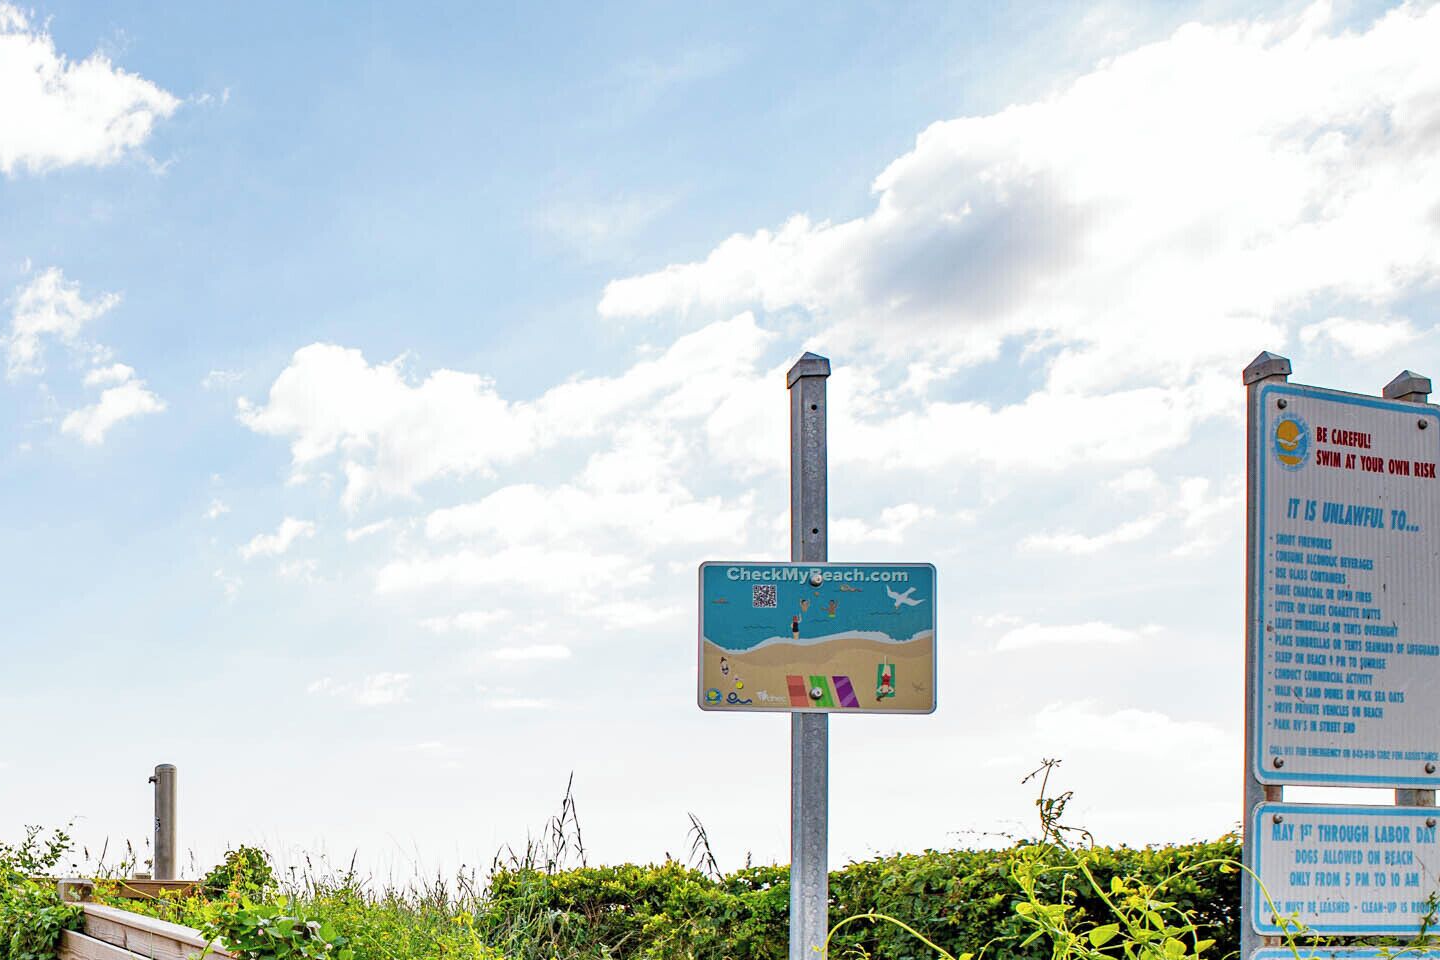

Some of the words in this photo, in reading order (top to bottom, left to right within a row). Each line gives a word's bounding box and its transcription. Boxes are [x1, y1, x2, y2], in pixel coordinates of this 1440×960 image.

[1317, 427, 1327, 442] BE
[1332, 430, 1370, 448] CAREFUL!
[1316, 450, 1340, 467] SWIM
[1346, 457, 1356, 469] AT
[1361, 457, 1383, 473] YOUR
[1388, 459, 1409, 475] OWN
[1414, 462, 1436, 478] RISK
[1288, 498, 1300, 519] IT
[1305, 500, 1316, 521] IS
[1322, 502, 1384, 528] UNLAWFUL
[1391, 510, 1419, 532] TO...
[1298, 536, 1331, 550] FIREWORKS
[1276, 551, 1303, 563] CONSUME
[1307, 553, 1337, 567] ALCOHOLIC
[1340, 557, 1373, 570] BEVERAGES
[727, 567, 908, 584] CheckMyBeach.com
[1276, 567, 1286, 578] USE
[1290, 569, 1307, 580] GLASS
[1311, 571, 1346, 584] CONTAINERS
[1275, 584, 1290, 596] HAVE
[1294, 585, 1323, 598] CHARCOAL
[1326, 588, 1334, 600] OR
[1337, 588, 1352, 601] OPEN
[1356, 591, 1372, 603] FIRES
[1275, 600, 1294, 612] LITTER
[1298, 602, 1305, 614] OR
[1309, 604, 1326, 616] LEAVE
[1329, 605, 1359, 618] CIGARETTE
[1362, 608, 1380, 620] BUTTS
[1275, 618, 1292, 630] LEAVE
[1295, 620, 1329, 632] UMBRELLAS
[1333, 622, 1340, 633] OR
[1344, 623, 1361, 635] TENTS
[1364, 625, 1398, 637] OVERNIGHT
[1275, 635, 1293, 647] PLACE
[1296, 637, 1330, 649] UMBRELLAS
[1333, 639, 1341, 650] OR
[1344, 640, 1362, 652] TENTS
[1397, 643, 1404, 654] OF
[1275, 651, 1292, 663] SLEEP
[1295, 653, 1304, 664] ON
[1307, 654, 1326, 665] BEACH
[1336, 656, 1345, 667] PM
[1349, 657, 1357, 668] TO
[1360, 657, 1385, 669] SUNRISE
[1274, 668, 1301, 680] CONDUCT
[1305, 670, 1343, 683] COMMERCIAL
[1346, 673, 1372, 686] ACTIVITY
[1275, 685, 1291, 696] WALK
[1306, 687, 1321, 699] SAND
[1324, 688, 1343, 700] DUNES
[1346, 689, 1354, 700] OR
[1358, 690, 1372, 702] PICK
[1375, 691, 1385, 702] SEA
[1389, 692, 1404, 703] OATS
[1274, 702, 1292, 713] DRIVE
[1295, 703, 1319, 715] PRIVATE
[1323, 704, 1349, 716] VEHICLES
[1352, 707, 1360, 717] ON
[1364, 707, 1383, 719] BEACH
[1274, 719, 1290, 730] PARK
[1310, 720, 1316, 731] IN
[1320, 721, 1340, 732] STREET
[1344, 722, 1355, 733] END
[1272, 824, 1294, 841] MAY
[1318, 825, 1368, 842] THROUGH
[1375, 826, 1410, 843] LABOR
[1416, 827, 1436, 843] DAY
[1295, 849, 1318, 864] DOGS
[1323, 850, 1363, 864] ALLOWED
[1368, 850, 1380, 864] ON
[1385, 851, 1413, 864] BEACH
[1290, 872, 1310, 886] ONLY
[1315, 872, 1340, 886] FROM
[1345, 873, 1350, 886] 5
[1355, 873, 1369, 886] PM
[1375, 873, 1385, 886] TO
[1391, 873, 1400, 886] 10
[1404, 873, 1419, 886] AM
[1286, 902, 1304, 912] MUST
[1308, 902, 1316, 912] BE
[1320, 902, 1350, 913] LEASHED
[1362, 902, 1397, 913] CLEAN-UP
[1401, 902, 1408, 913] IS
